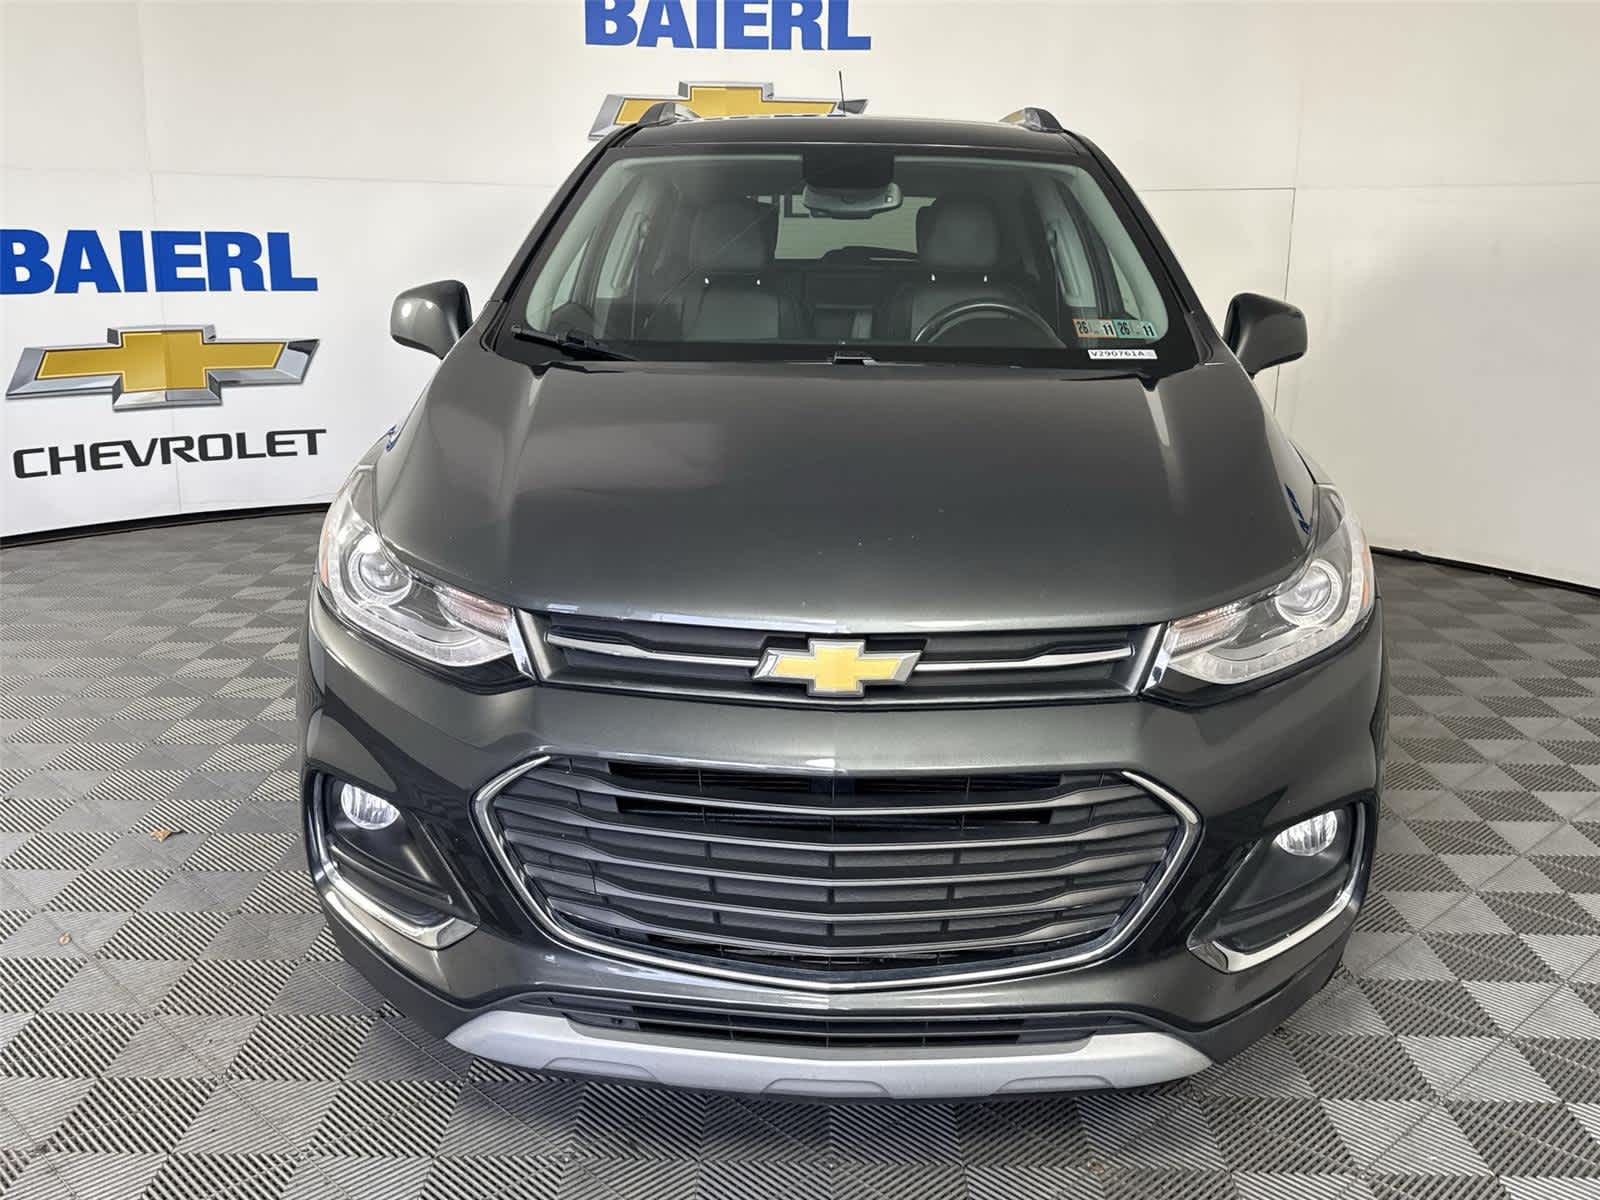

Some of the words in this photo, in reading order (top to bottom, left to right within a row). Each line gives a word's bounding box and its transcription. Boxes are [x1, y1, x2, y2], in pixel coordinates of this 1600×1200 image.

[584, 0, 872, 50] BAIERL
[0, 229, 318, 295] BAIERL
[1102, 323, 1115, 336] 11
[1142, 325, 1155, 337] 11
[13, 428, 327, 480] CHEVROLET
